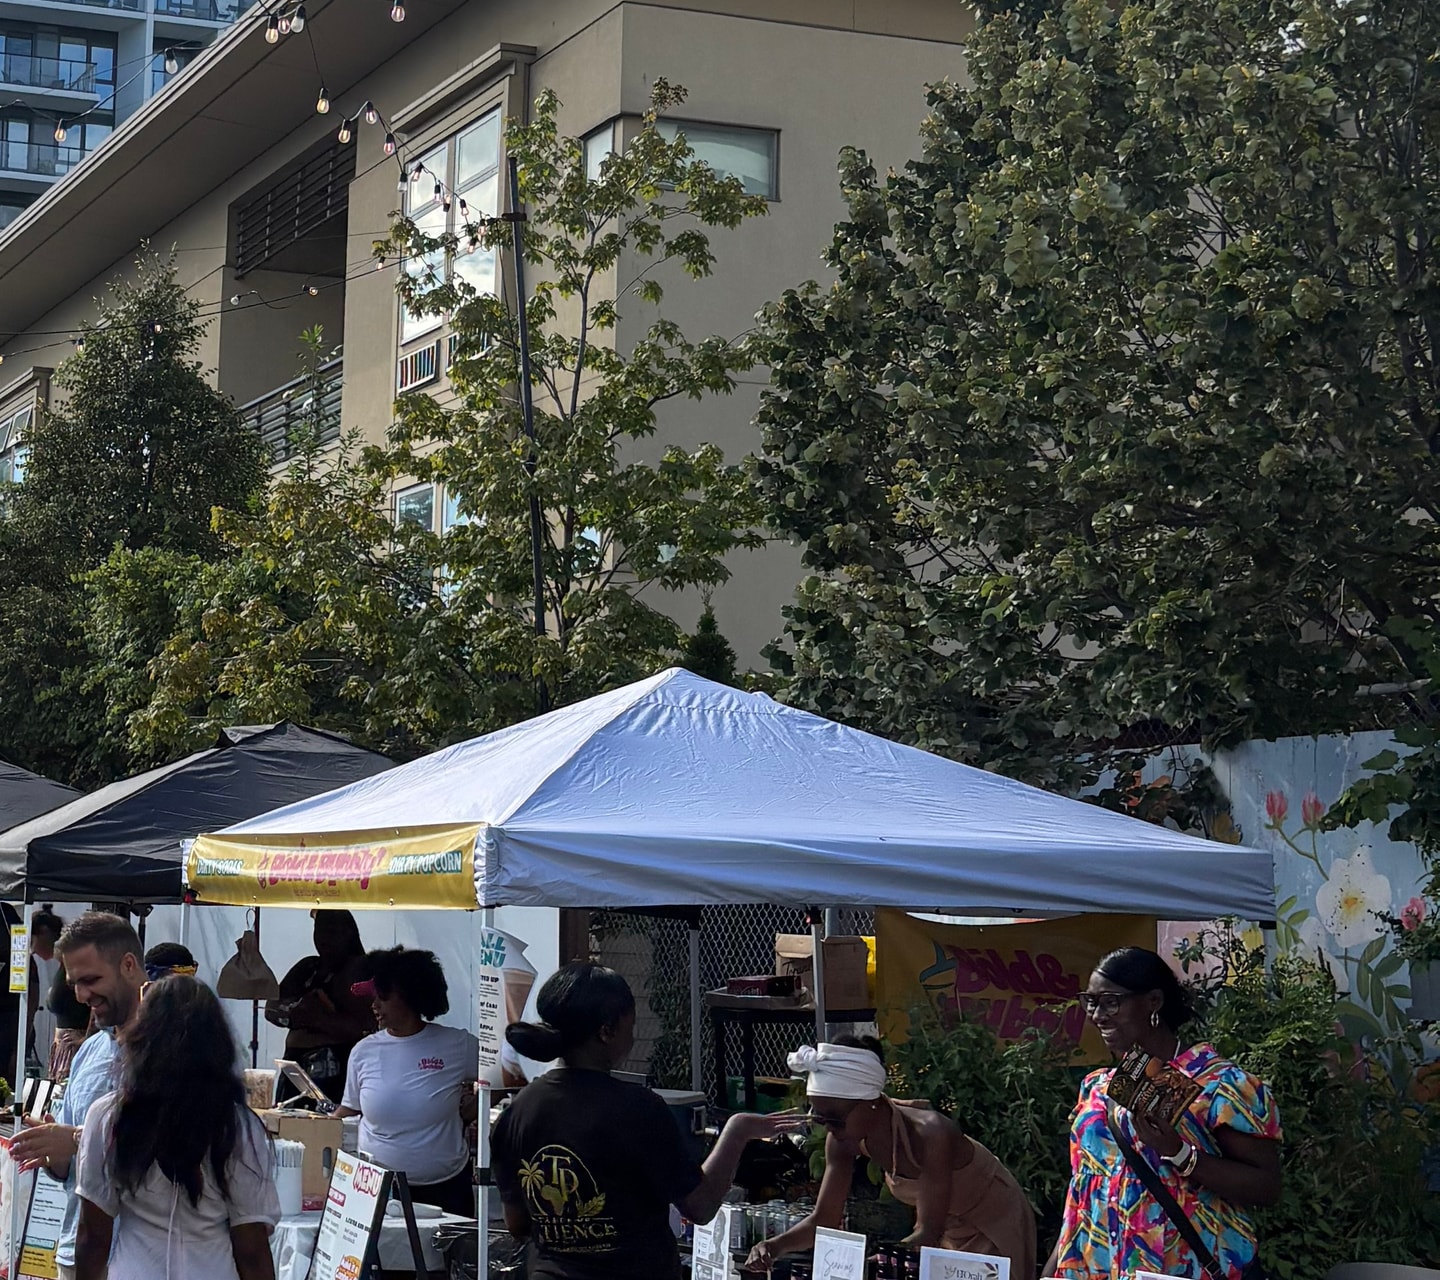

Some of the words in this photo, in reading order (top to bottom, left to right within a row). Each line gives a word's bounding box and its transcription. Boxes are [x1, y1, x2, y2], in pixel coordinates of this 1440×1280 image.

[388, 853, 417, 875] DIRTY
[416, 851, 463, 874] POPCORN
[353, 1162, 382, 1198] MENU
